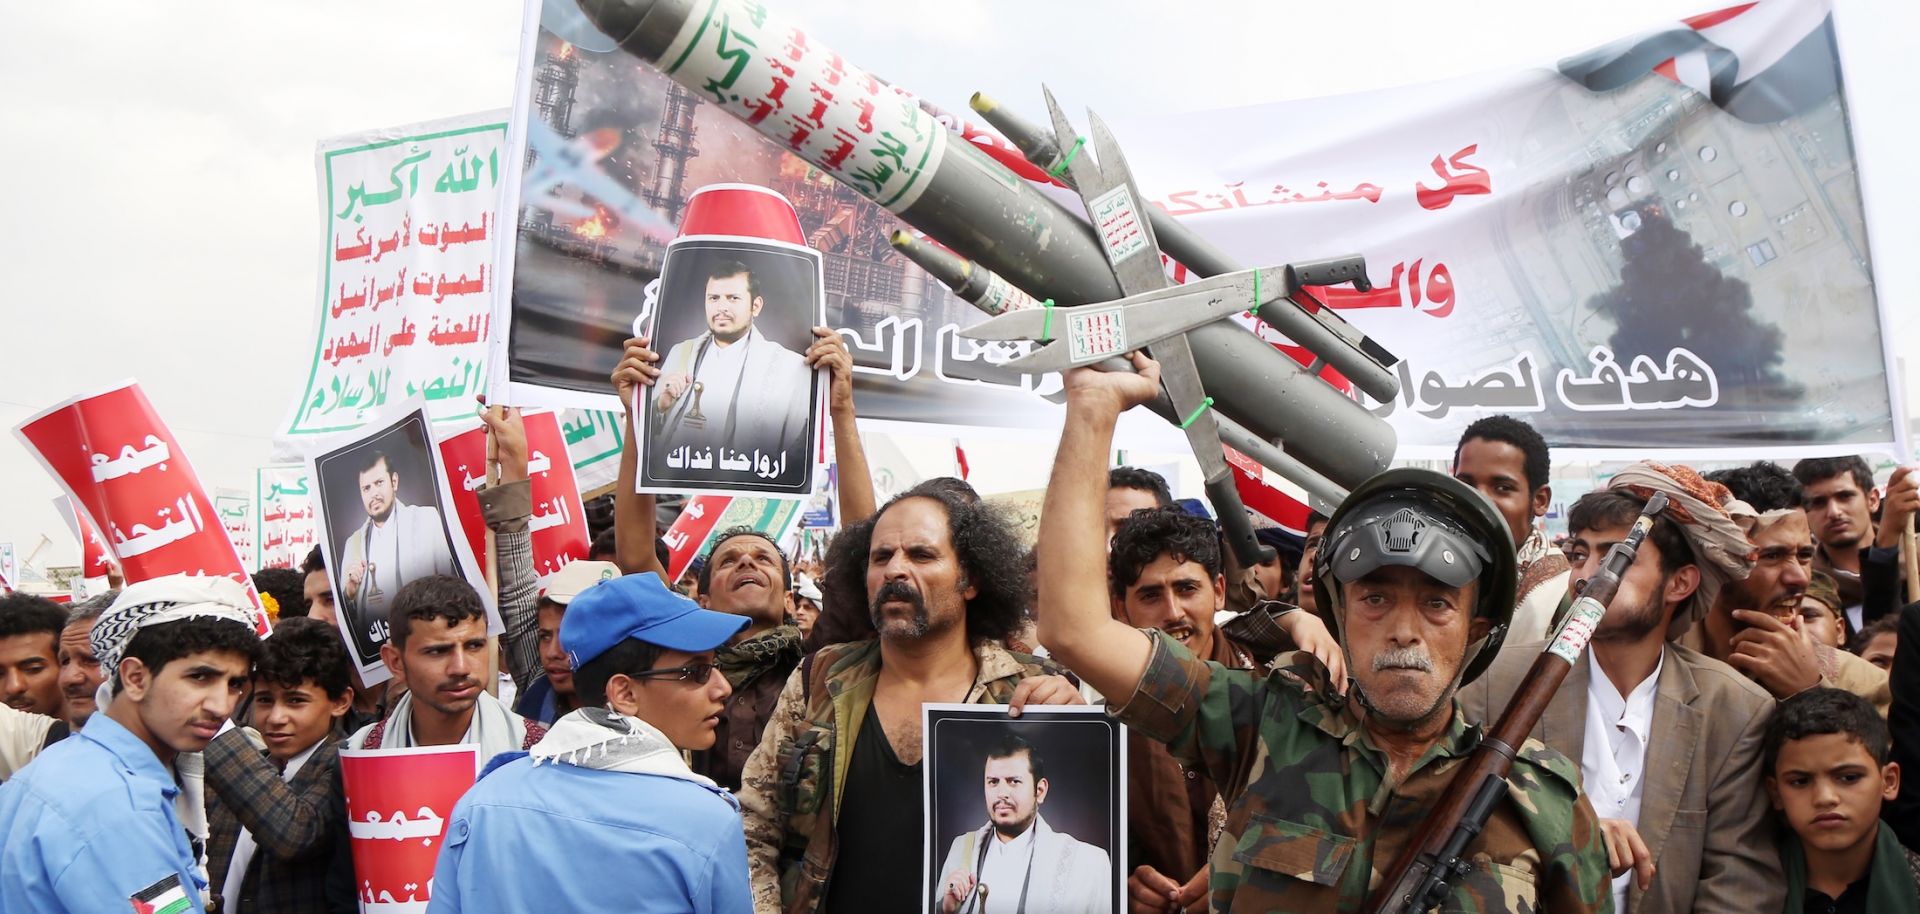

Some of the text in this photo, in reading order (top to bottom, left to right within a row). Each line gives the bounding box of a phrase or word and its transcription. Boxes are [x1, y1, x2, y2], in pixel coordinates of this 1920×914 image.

[336, 145, 499, 224] الله أكبر
[1416, 143, 1492, 210] كل
[336, 210, 494, 264] الموت لأمريكا
[331, 263, 492, 319] الموت لإسرائيل
[324, 312, 490, 367] اللعنة على اليهود
[305, 366, 391, 422] للإسلام
[1558, 347, 1716, 411] هدف
[83, 434, 171, 483] جمع
[666, 446, 787, 479] ارواحنا فداك
[264, 476, 308, 502] كبر
[111, 491, 204, 559] التحذ
[347, 797, 444, 847] جمع
